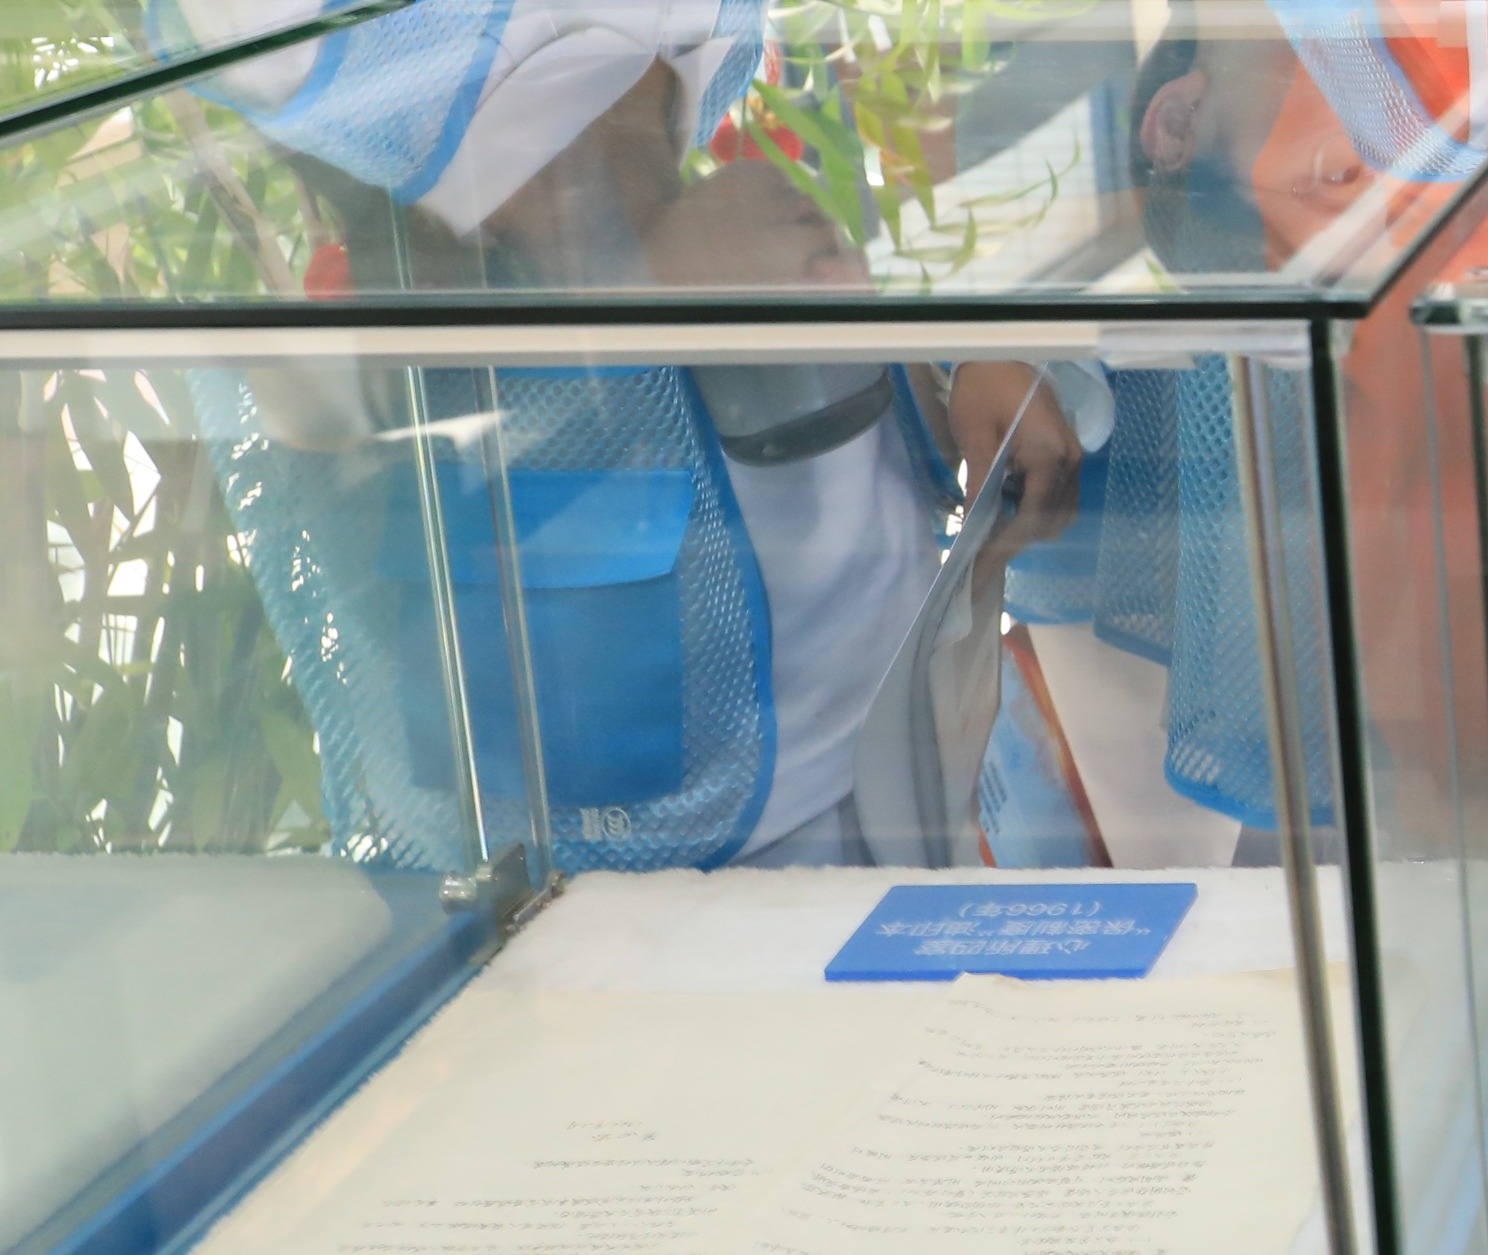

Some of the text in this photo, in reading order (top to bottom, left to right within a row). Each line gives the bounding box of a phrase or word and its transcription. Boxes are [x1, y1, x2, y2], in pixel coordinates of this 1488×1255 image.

[914, 939, 1091, 956] 心理所四室
